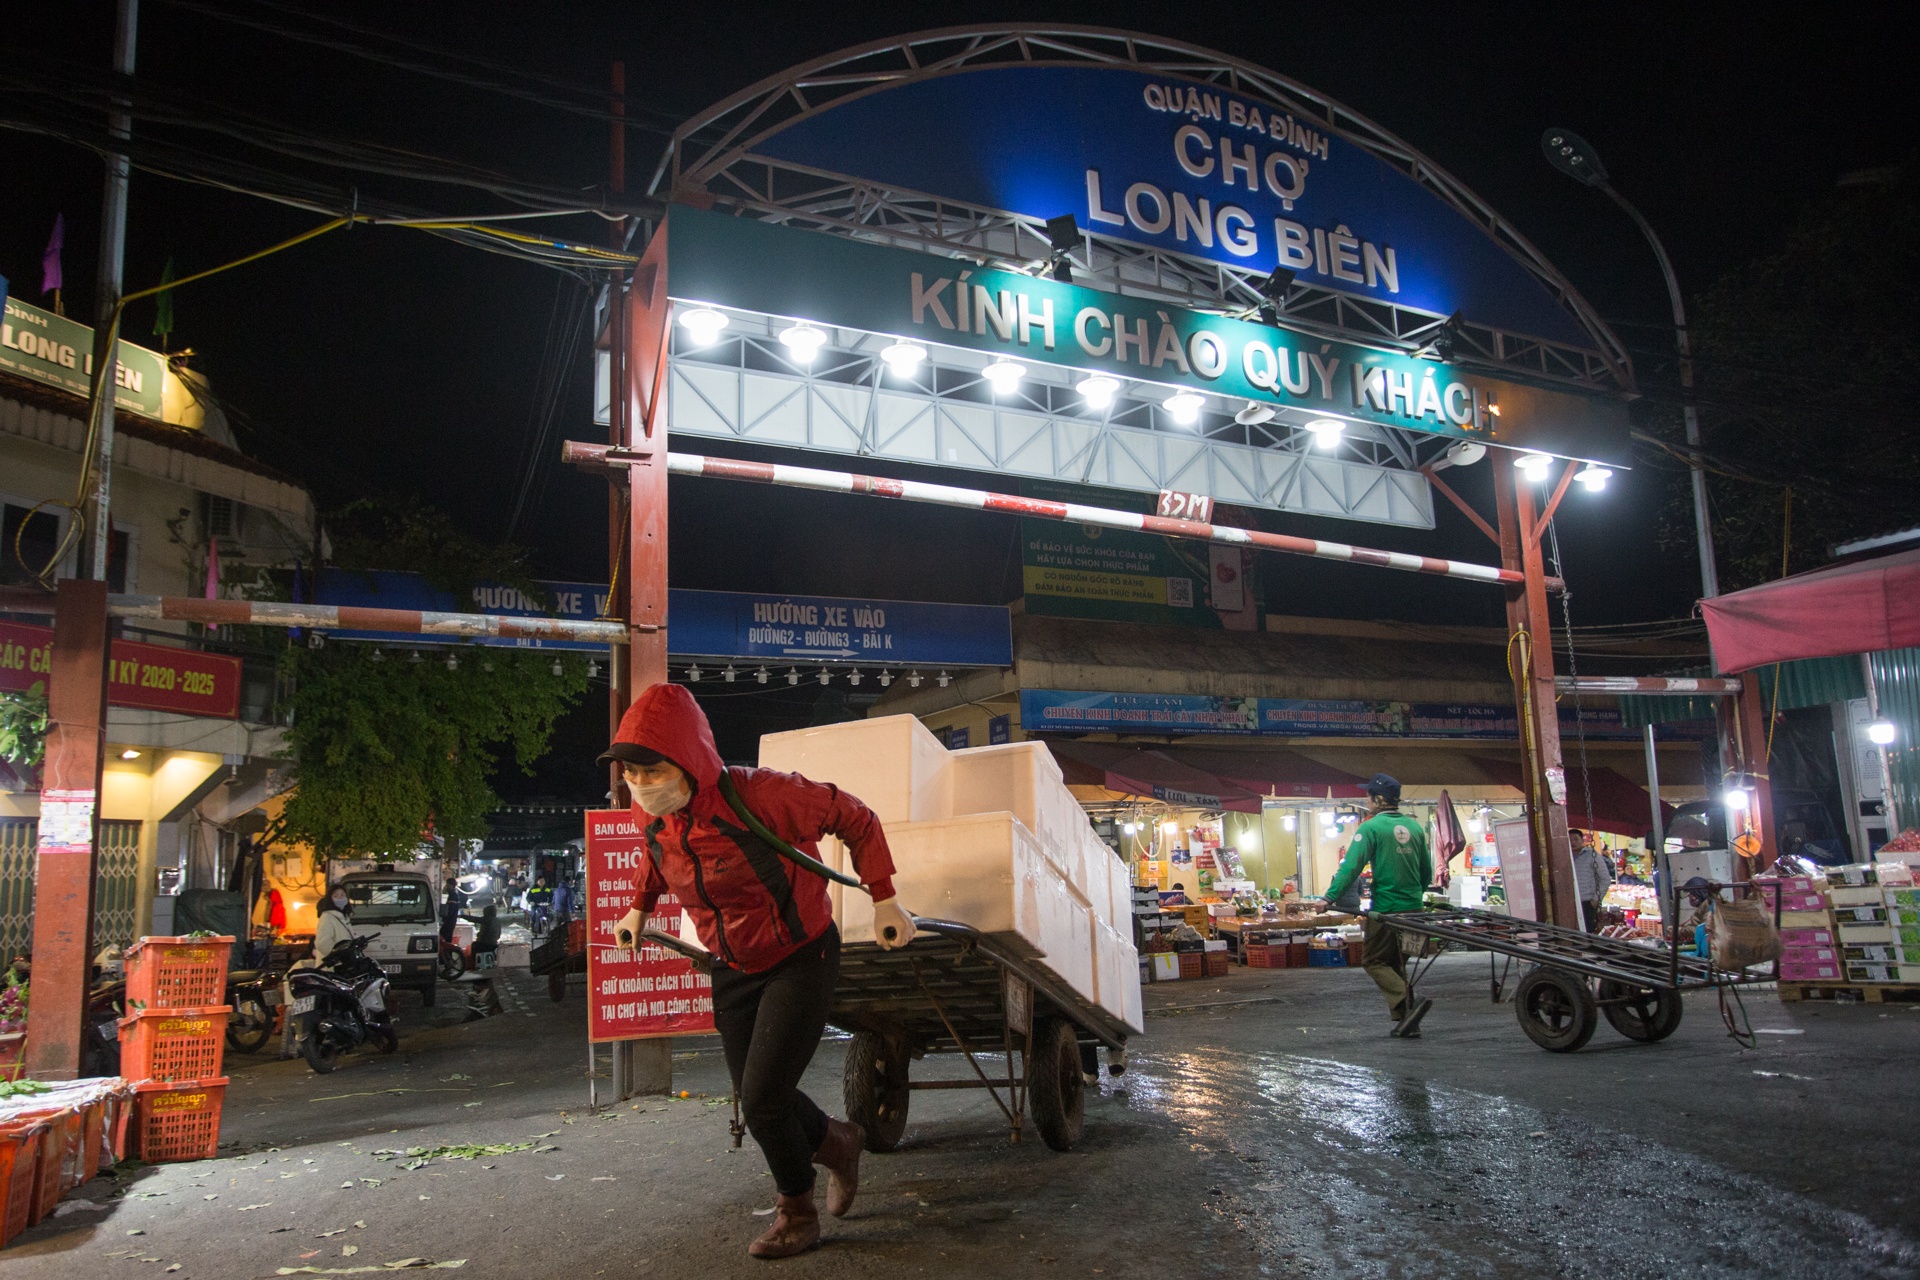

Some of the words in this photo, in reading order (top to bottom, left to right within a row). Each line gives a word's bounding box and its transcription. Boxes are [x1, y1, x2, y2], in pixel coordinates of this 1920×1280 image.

[1143, 82, 1222, 122] QUẬN
[1229, 97, 1266, 133] BA
[1270, 113, 1330, 161] ĐÌNH
[1174, 124, 1309, 211] CHỢ
[1086, 169, 1258, 257] LONG
[1275, 216, 1400, 294] BIÊN
[2, 324, 76, 370] LONG
[911, 269, 1056, 351] KÍNH
[1074, 307, 1228, 381] CHÀO
[1241, 342, 1341, 401] QUÝ
[1352, 362, 1499, 434] KHÁCH
[556, 592, 583, 615] XE
[753, 598, 819, 627] HƯỚNG
[824, 606, 850, 628] XE
[852, 602, 886, 630] VÀO
[863, 630, 882, 651] BÃI
[884, 634, 893, 651] K
[120, 658, 139, 685] KỲ
[1043, 706, 1084, 719] CHUYÊN
[1085, 708, 1112, 720] KINH
[1113, 708, 1149, 721] DOANH
[594, 823, 615, 836] BAN
[598, 879, 612, 891] YÊU
[613, 877, 627, 891] CẦU
[596, 893, 609, 908] CHỈ
[609, 896, 621, 909] THỊ
[601, 976, 618, 995] GIỮ
[619, 972, 654, 994] KHOẢNG
[655, 973, 678, 992] CÁCH
[680, 969, 694, 990] TỐI
[601, 1004, 615, 1023] TẠI
[617, 1002, 635, 1021] CHỢ
[637, 999, 648, 1017] VÀ
[667, 997, 690, 1014] CÔNG
